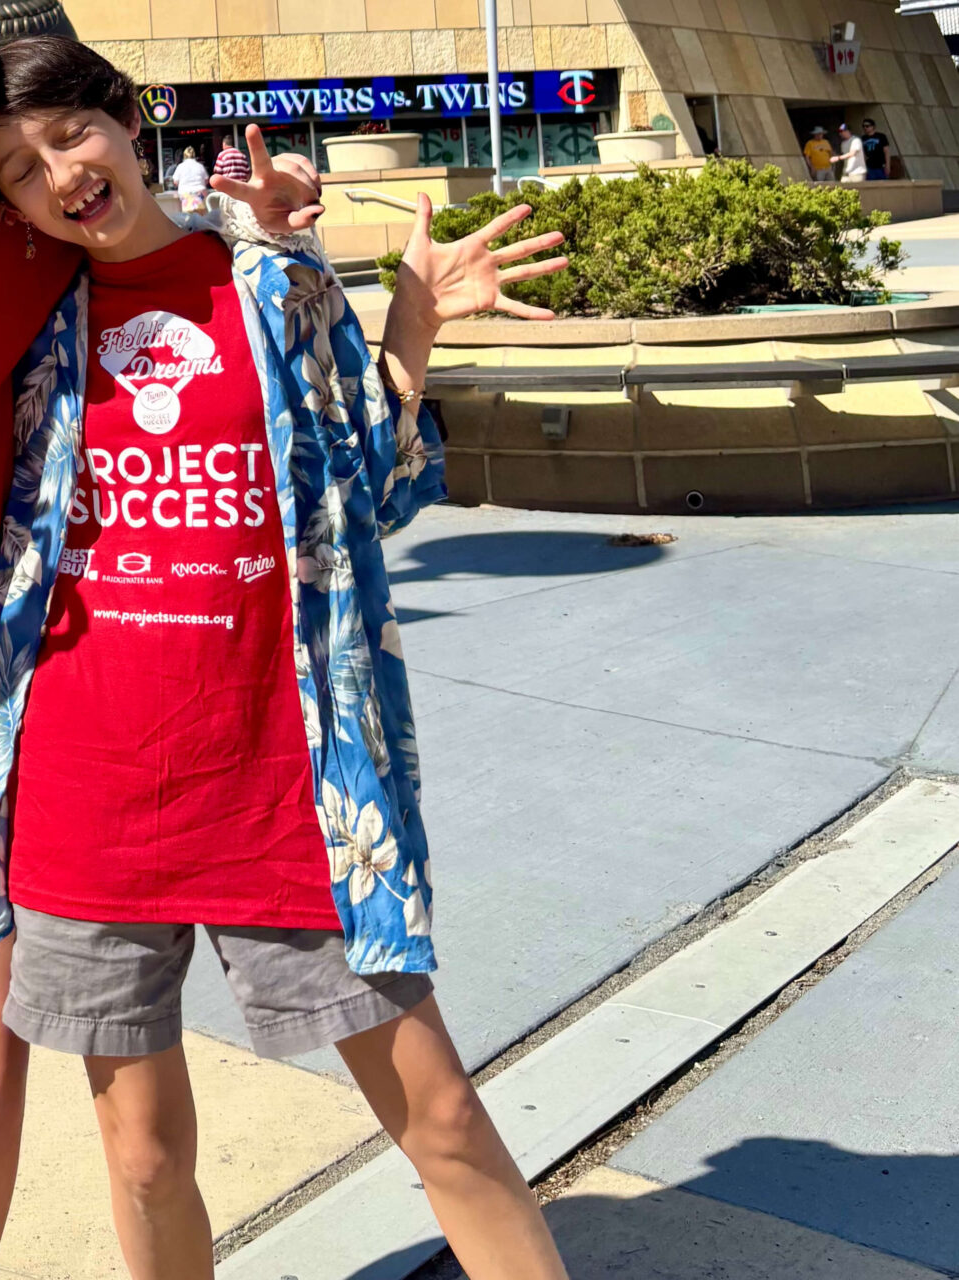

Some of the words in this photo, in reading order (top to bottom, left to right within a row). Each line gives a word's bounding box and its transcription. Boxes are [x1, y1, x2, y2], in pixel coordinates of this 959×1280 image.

[210, 86, 376, 118] BREWERS
[380, 90, 412, 108] vs.
[415, 80, 527, 111] TWINS
[96, 321, 191, 358] Fielding
[125, 354, 224, 380] Dreams
[62, 548, 96, 564] BEST
[60, 560, 91, 578] BUY
[102, 575, 145, 584] BRIDGEWATER
[146, 577, 163, 585] BANK
[233, 554, 276, 583] Twins
[93, 609, 234, 630] www.projectsuccess.org
